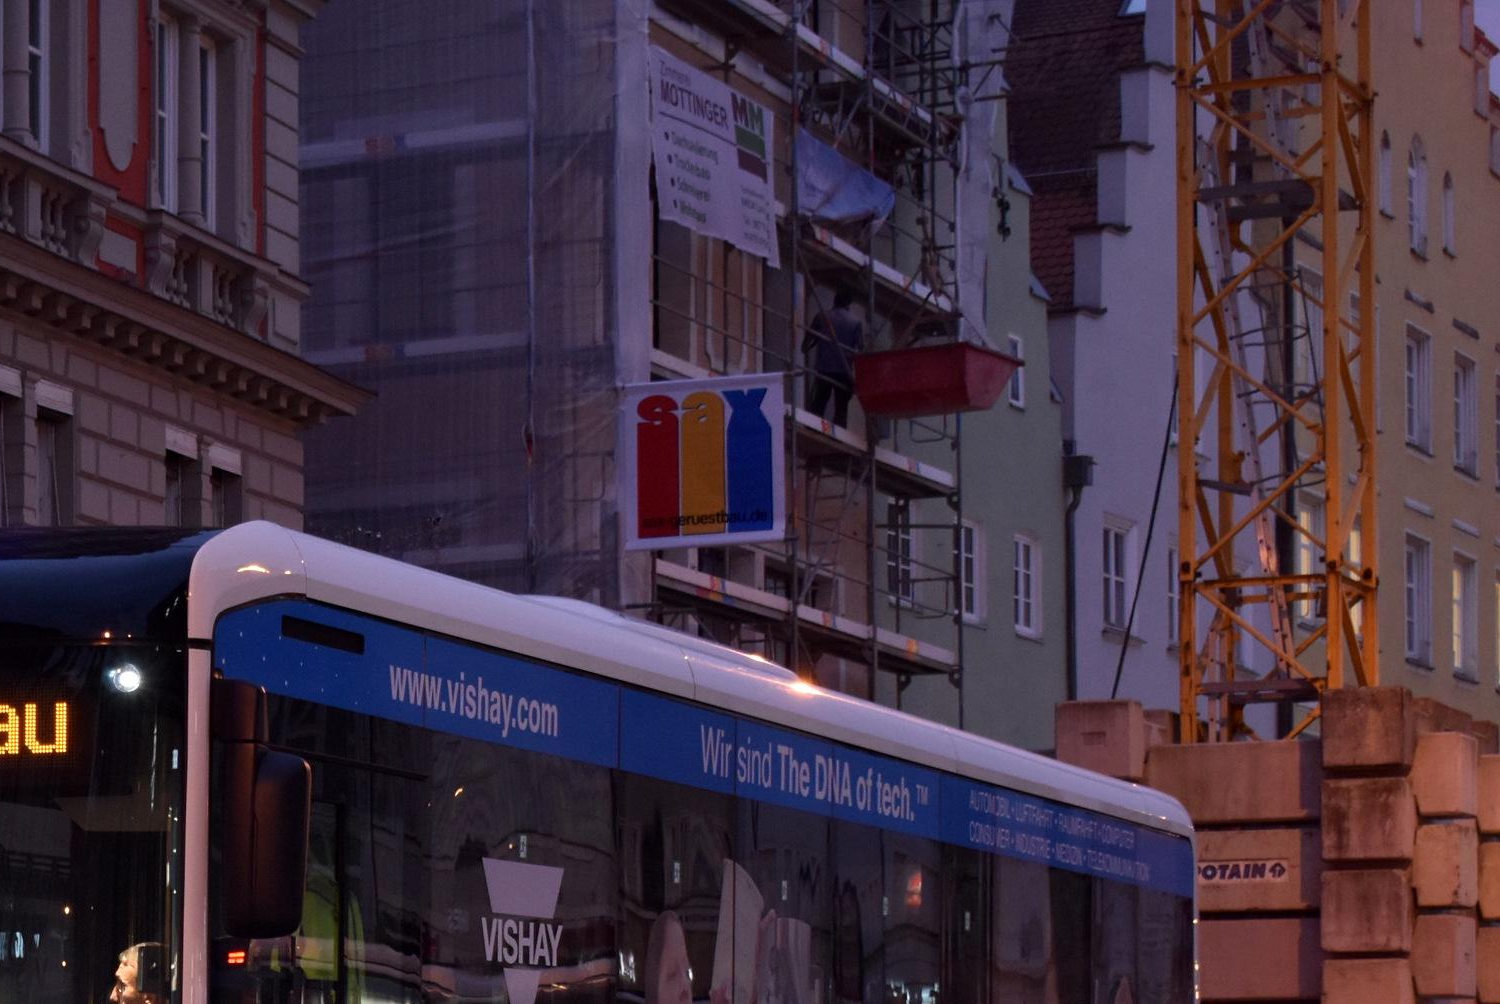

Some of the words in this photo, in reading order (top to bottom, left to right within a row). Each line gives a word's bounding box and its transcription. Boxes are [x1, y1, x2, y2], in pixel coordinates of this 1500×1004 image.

[660, 79, 729, 131] MOTTINGER
[730, 92, 765, 138] MM
[636, 387, 773, 539] sax
[388, 664, 559, 738] www.vishay.com
[700, 724, 733, 780] Wir
[737, 734, 773, 789] sind
[776, 743, 811, 796] The
[814, 753, 853, 807] DNA
[856, 766, 874, 808] of
[481, 916, 563, 968] VISHAY
